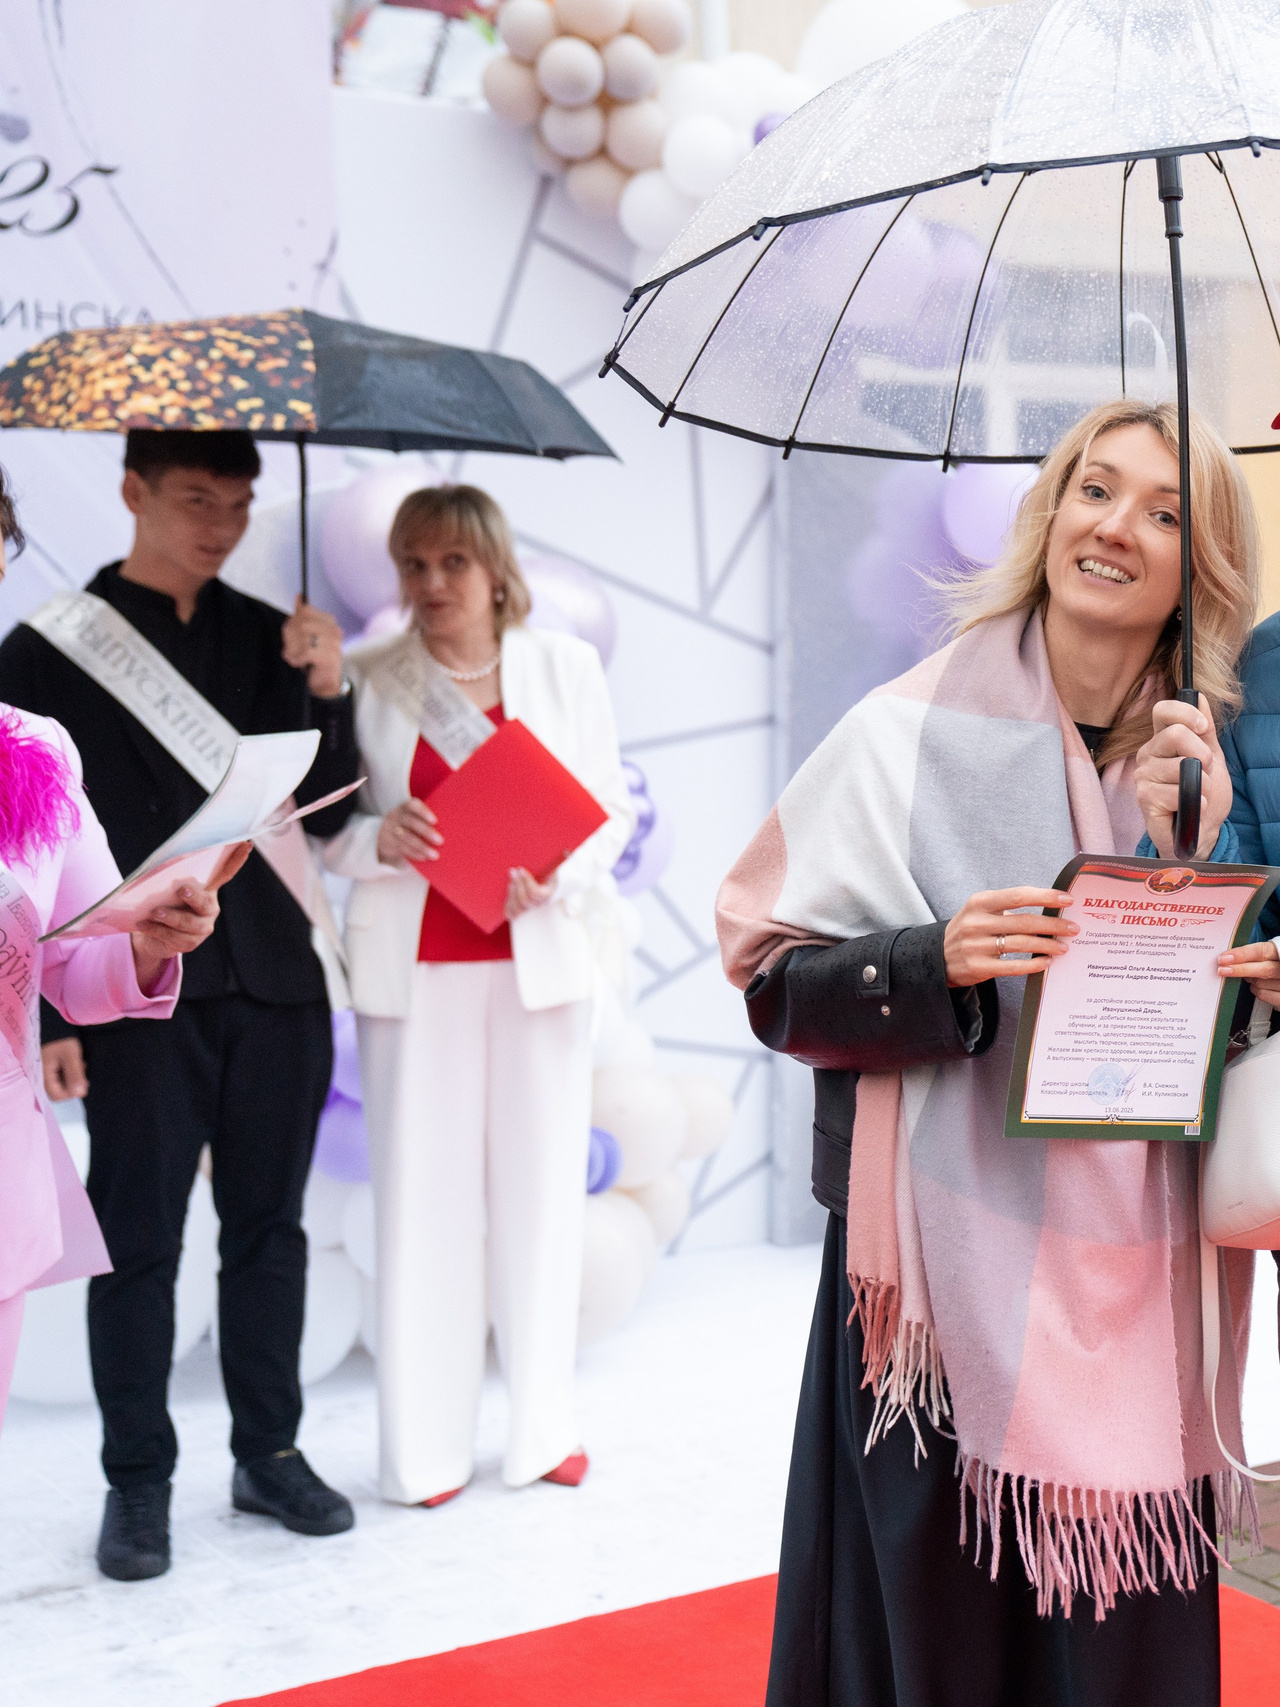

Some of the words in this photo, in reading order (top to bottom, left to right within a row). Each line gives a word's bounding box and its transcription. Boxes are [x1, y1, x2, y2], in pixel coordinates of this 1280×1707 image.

[1083, 898, 1225, 916] БЛАГОДАРСТВЕННОЕ
[1121, 915, 1178, 927] ПИСЬМО
[1086, 931, 1133, 939] Государственное
[1146, 966, 1190, 974] Александровне
[1141, 1057, 1171, 1065] свершений
